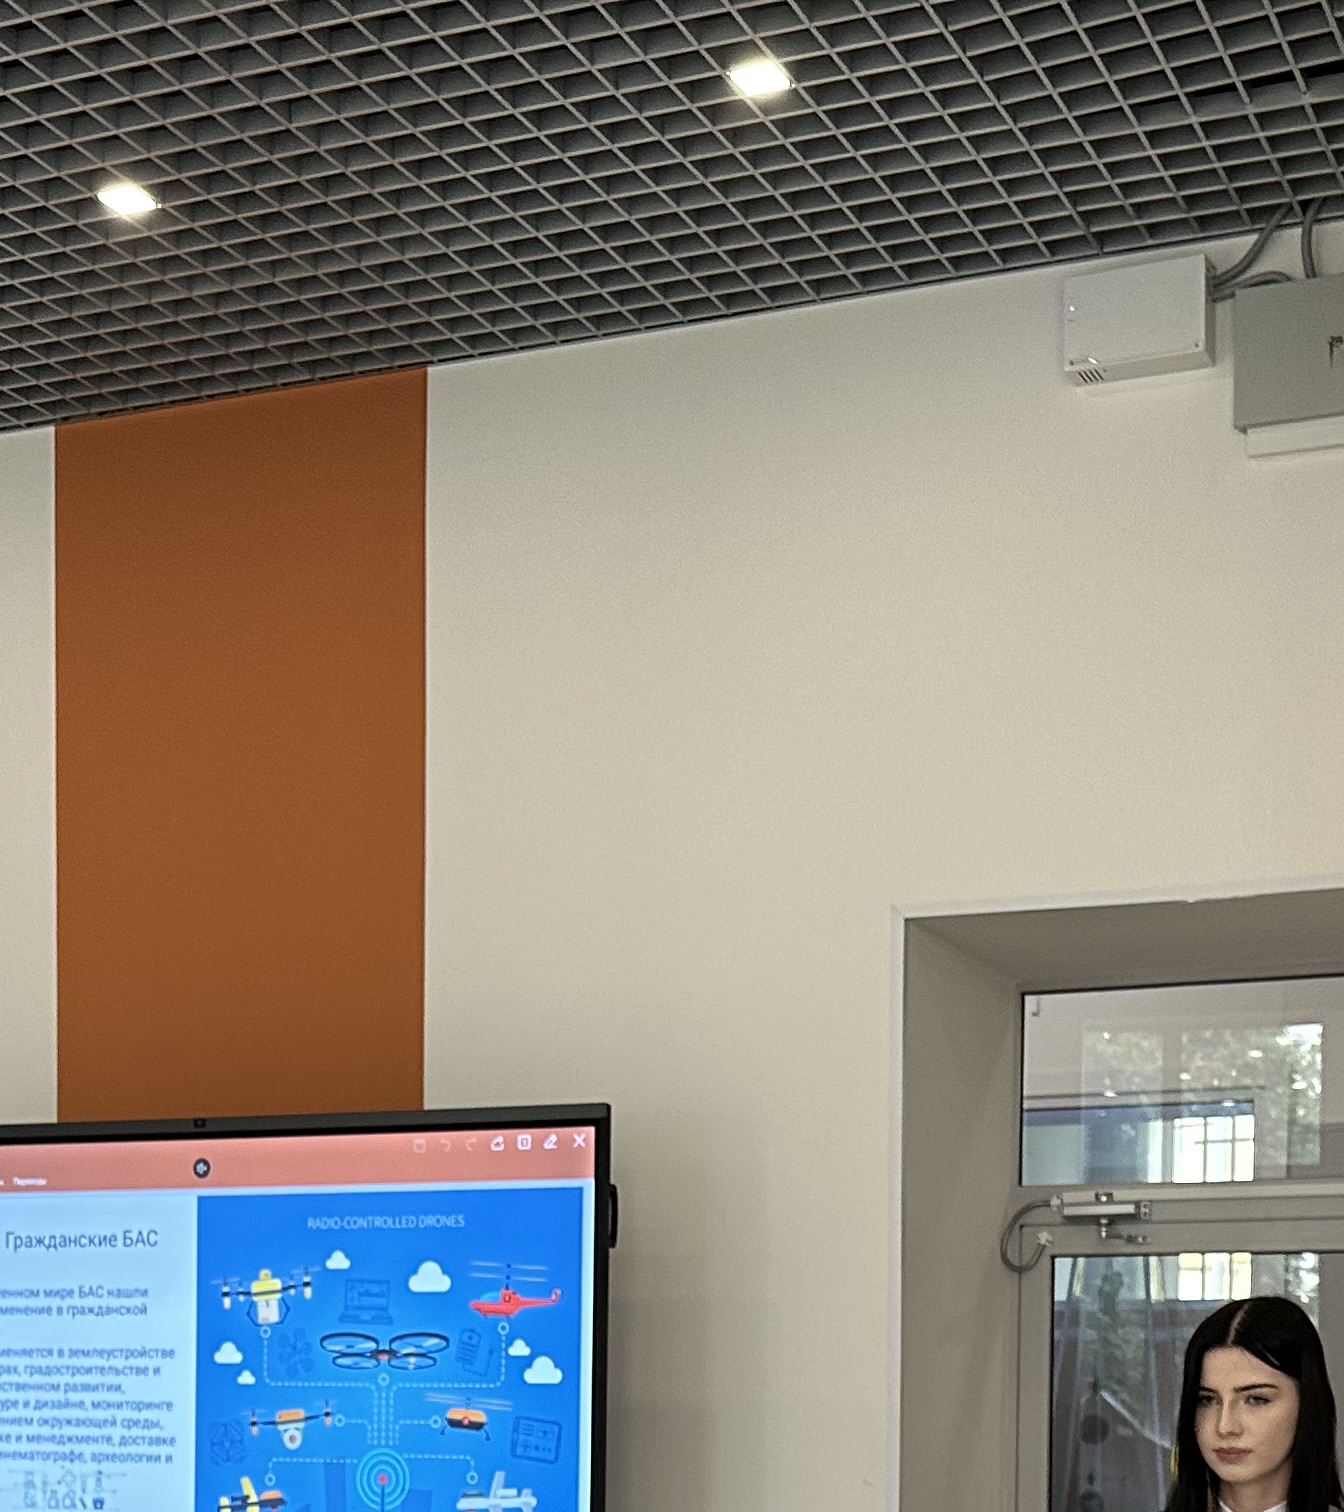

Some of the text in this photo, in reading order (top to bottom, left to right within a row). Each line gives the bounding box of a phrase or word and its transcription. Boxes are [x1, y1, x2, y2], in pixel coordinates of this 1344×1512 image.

[307, 1214, 465, 1230] RADIO-CONTROLLED DRONES
[5, 1230, 159, 1251] Гражданские БАС
[44, 1288, 75, 1300] мире
[79, 1285, 104, 1299] БАС
[107, 1288, 148, 1299] нашли
[57, 1306, 63, 1315] в
[67, 1303, 147, 1318] гражданской
[58, 1348, 64, 1358] в
[68, 1346, 175, 1362] землеустройстве
[24, 1365, 149, 1377] градостроительстве
[153, 1367, 161, 1376] и
[64, 1382, 125, 1395] развитии,
[23, 1400, 30, 1409] и
[34, 1399, 88, 1411] дизайне,
[91, 1400, 173, 1413] мониторинге
[37, 1415, 117, 1430] окружающей
[120, 1417, 164, 1430] среды,
[15, 1434, 22, 1443] и
[26, 1434, 115, 1446] менеджменте,
[119, 1435, 176, 1447] доставке
[91, 1452, 161, 1464] археологии
[165, 1454, 172, 1463] и
